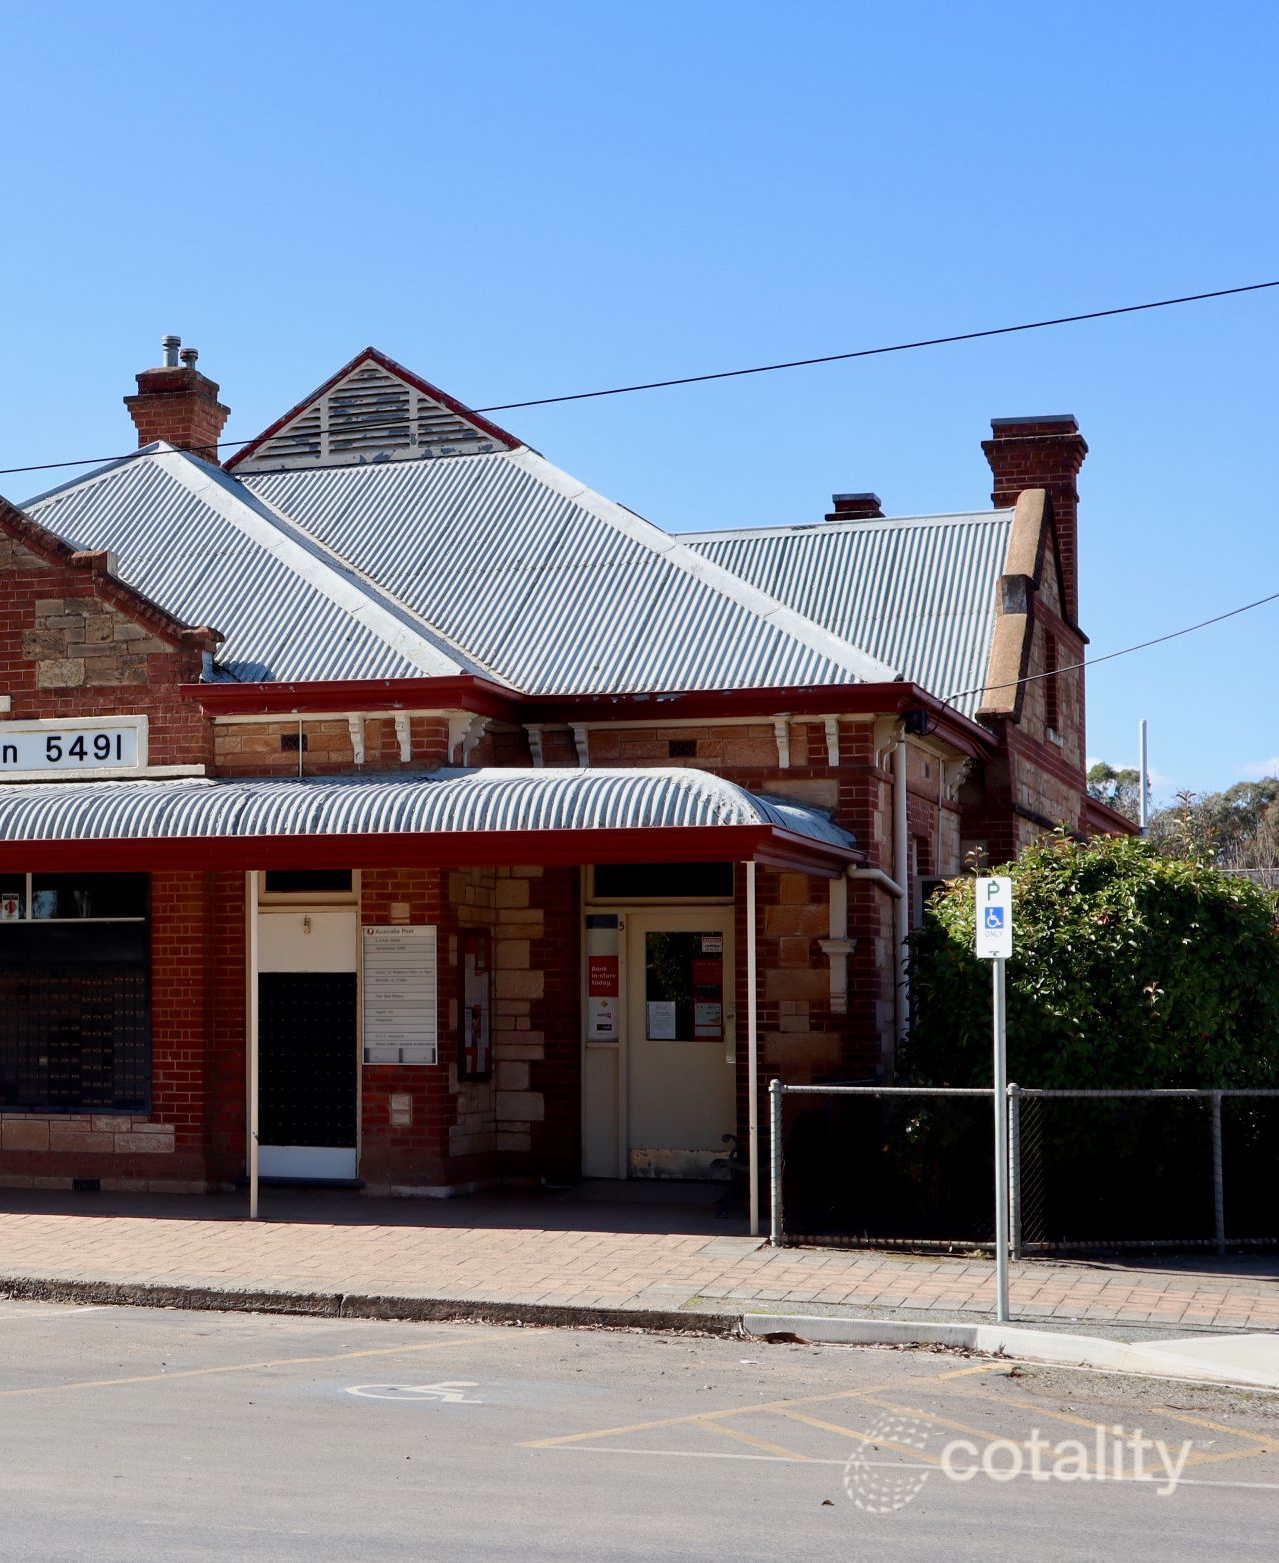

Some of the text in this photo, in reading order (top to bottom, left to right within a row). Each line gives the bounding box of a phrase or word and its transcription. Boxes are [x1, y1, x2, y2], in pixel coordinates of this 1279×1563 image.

[45, 733, 123, 763] 5491
[987, 882, 1000, 901] P
[619, 921, 625, 931] 5
[984, 930, 1003, 938] ONLY
